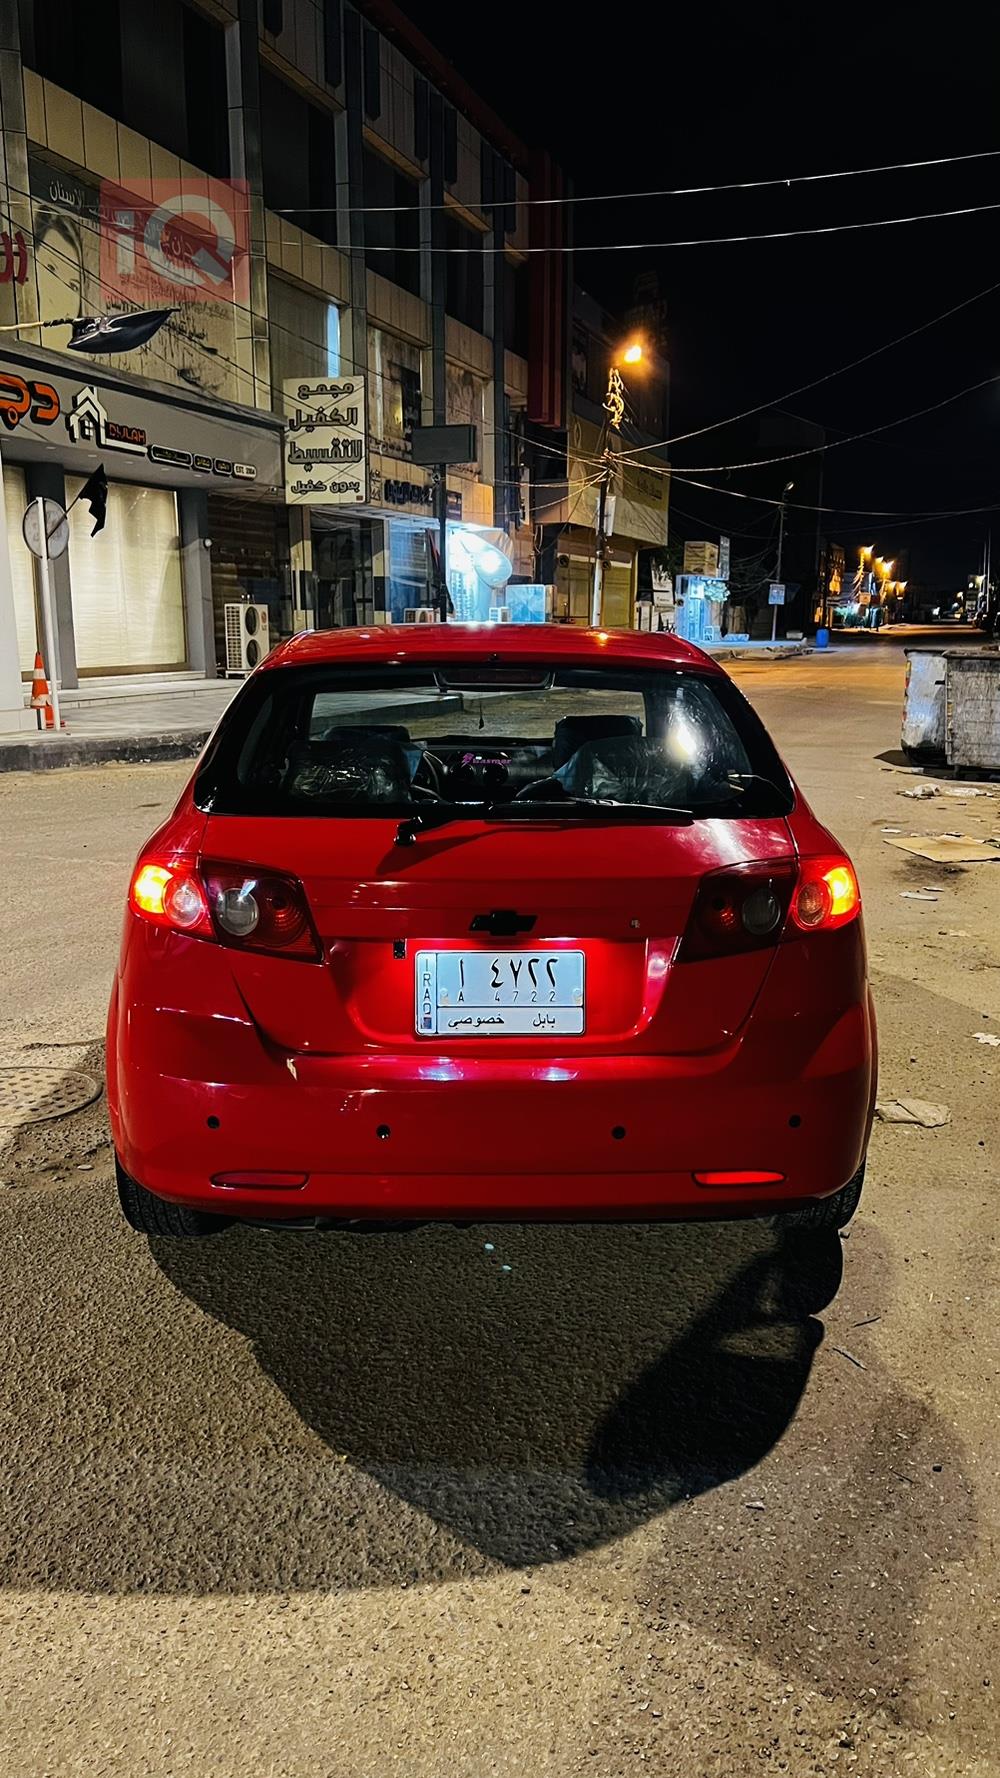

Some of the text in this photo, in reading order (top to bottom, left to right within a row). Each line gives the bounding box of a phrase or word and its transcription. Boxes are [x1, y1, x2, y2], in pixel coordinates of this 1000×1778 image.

[297, 382, 355, 400] مجمع
[288, 406, 359, 433] الكفيل
[287, 437, 363, 473] للتقسيط
[291, 478, 361, 494] بدون كفيل
[490, 958, 559, 989] ٤٧٢٢
[422, 958, 433, 1015] IRAQ
[457, 990, 465, 1002] A
[448, 1012, 556, 1030] بابل خصوصي
